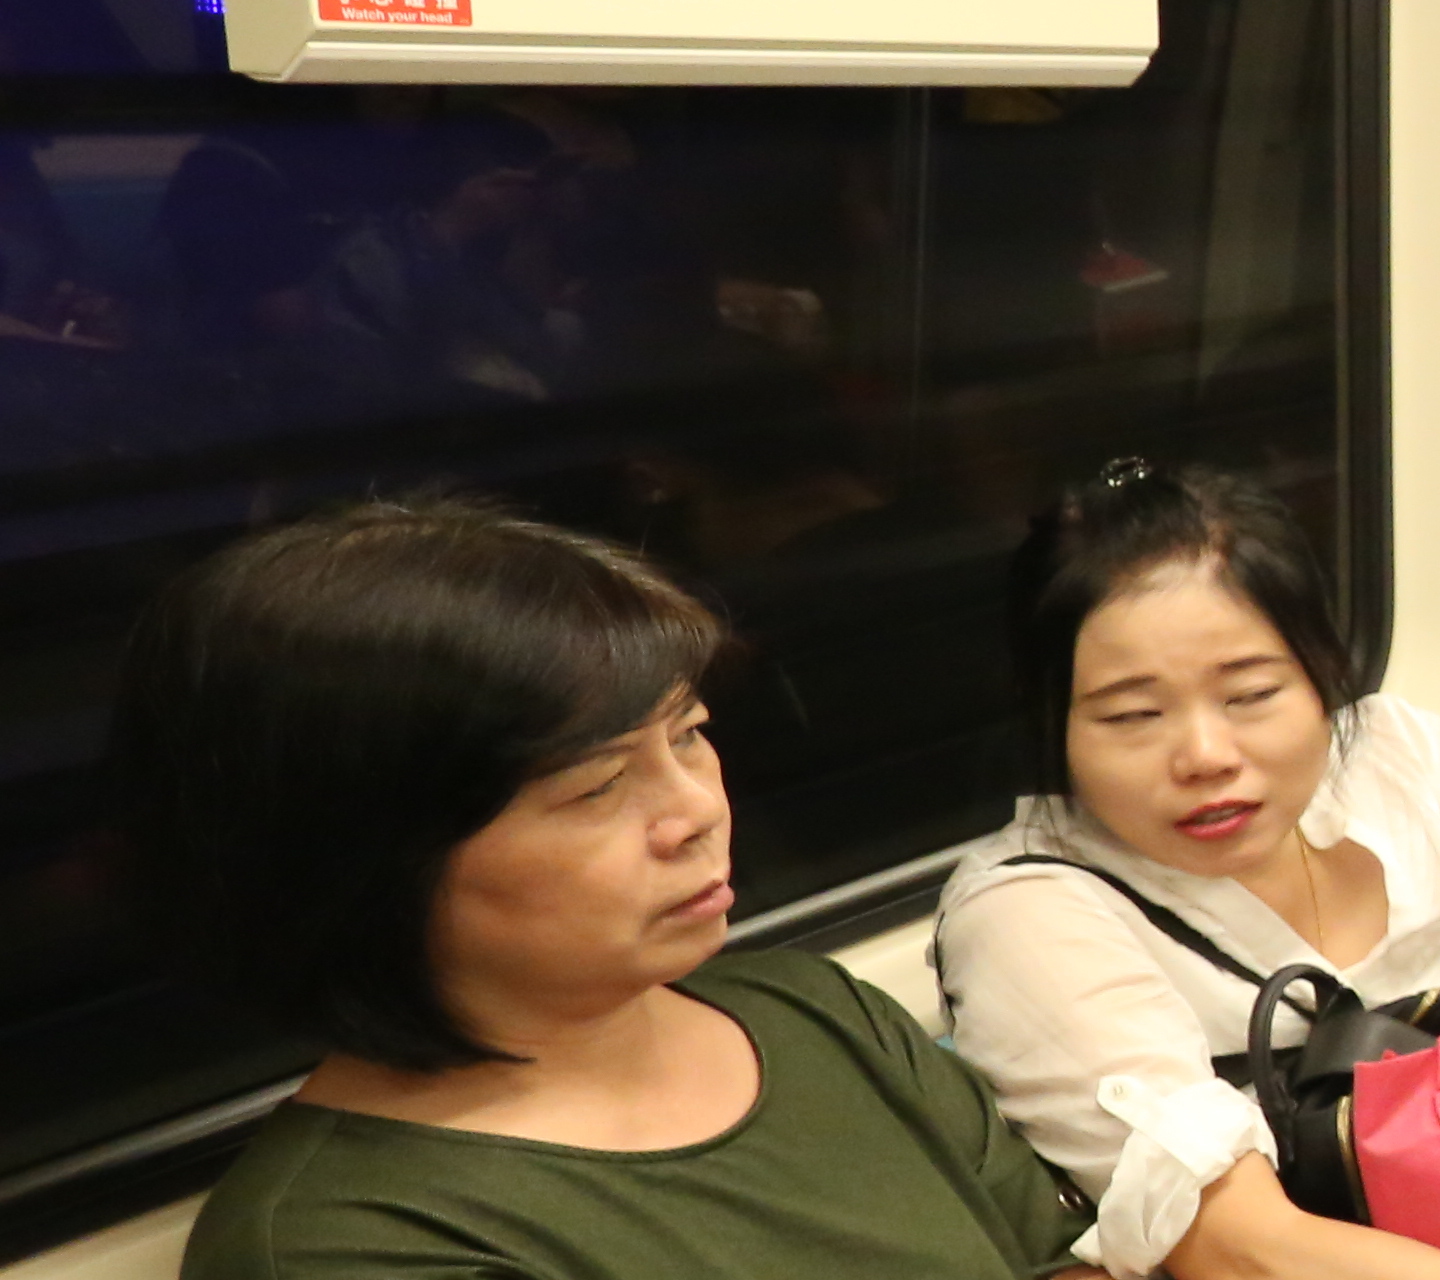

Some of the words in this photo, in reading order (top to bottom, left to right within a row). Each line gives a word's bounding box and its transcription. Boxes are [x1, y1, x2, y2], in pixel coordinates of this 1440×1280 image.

[341, 6, 385, 21] Watch
[388, 10, 418, 23] your
[420, 11, 453, 24] head
